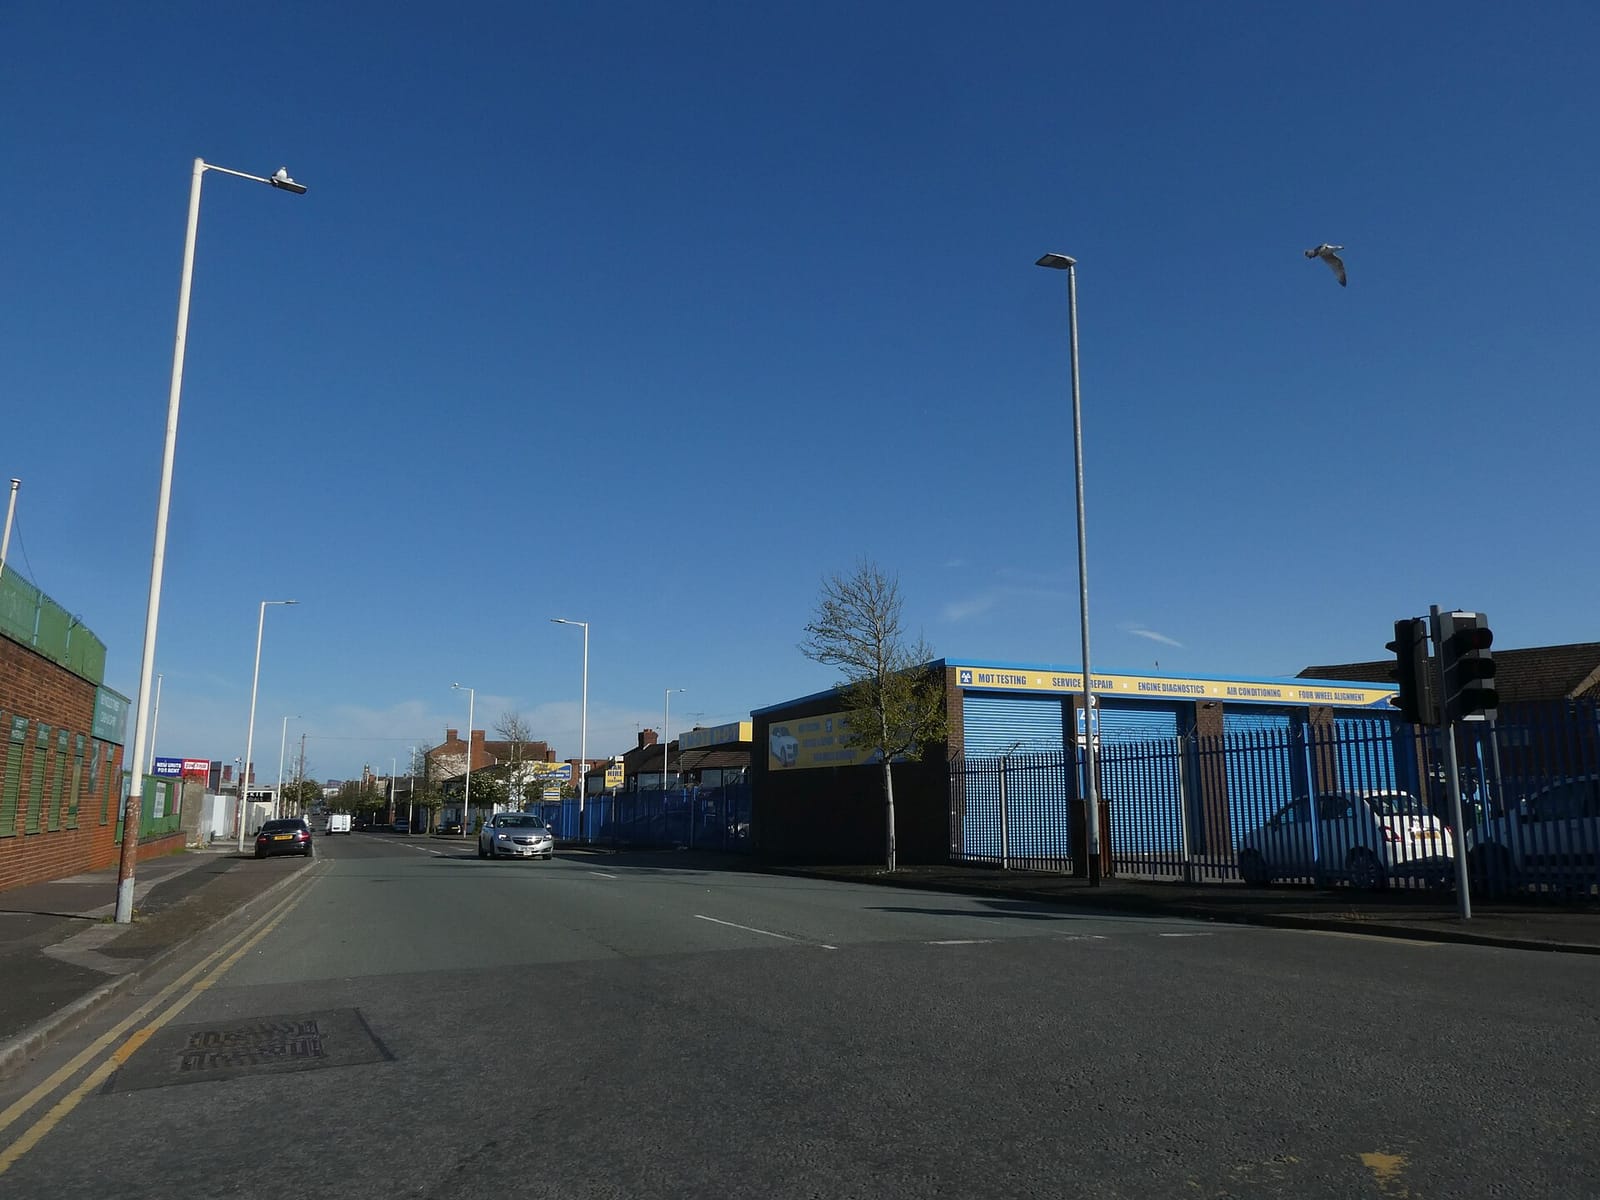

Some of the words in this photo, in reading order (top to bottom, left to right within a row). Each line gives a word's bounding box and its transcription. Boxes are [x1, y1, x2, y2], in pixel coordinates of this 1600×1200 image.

[978, 673, 994, 683] MOT
[996, 674, 1027, 685] TESTING
[1052, 677, 1081, 688] SERVICE
[1138, 682, 1161, 693] ENGINE
[1162, 683, 1205, 695] DIAGNOSTICS
[1226, 686, 1237, 696] AIR
[1238, 687, 1281, 698] CONDITIONING
[1298, 690, 1314, 700] FOUR
[1314, 691, 1333, 701] WHEEL
[1334, 691, 1365, 702] ALIGNMENT
